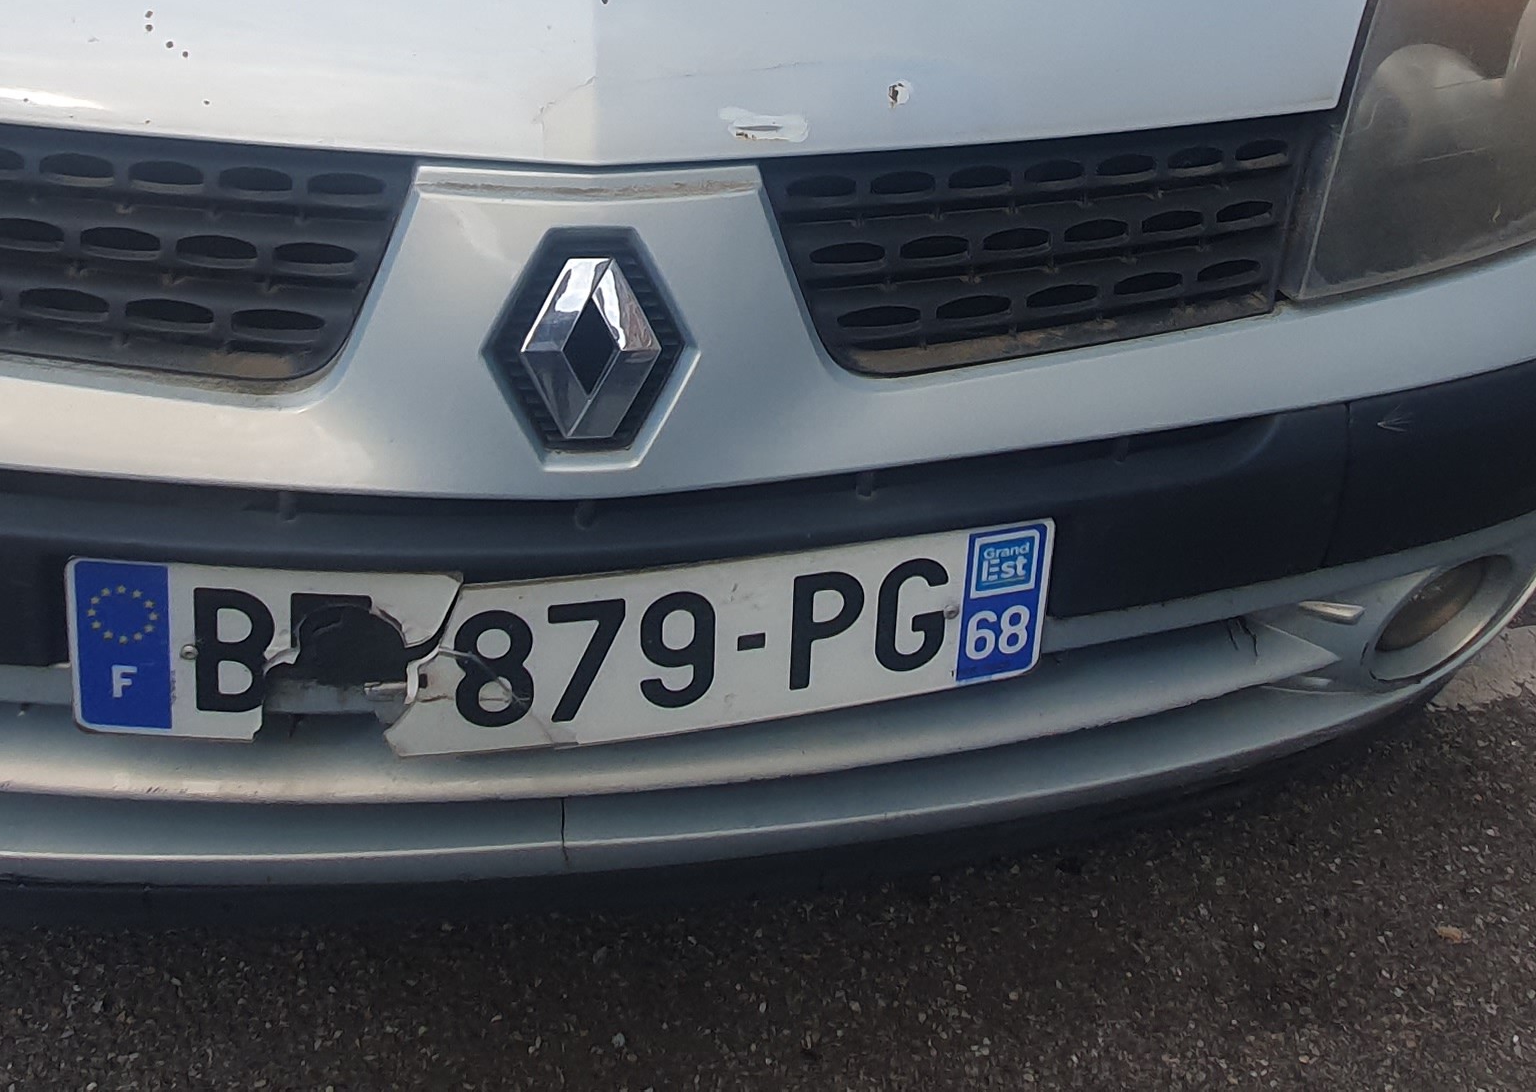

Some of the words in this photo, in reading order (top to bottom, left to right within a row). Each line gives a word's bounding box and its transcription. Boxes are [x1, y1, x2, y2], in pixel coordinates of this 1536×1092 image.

[983, 541, 1031, 559] Grand
[981, 555, 1028, 582] Est
[965, 604, 1031, 661] 68
[111, 664, 138, 699] F
